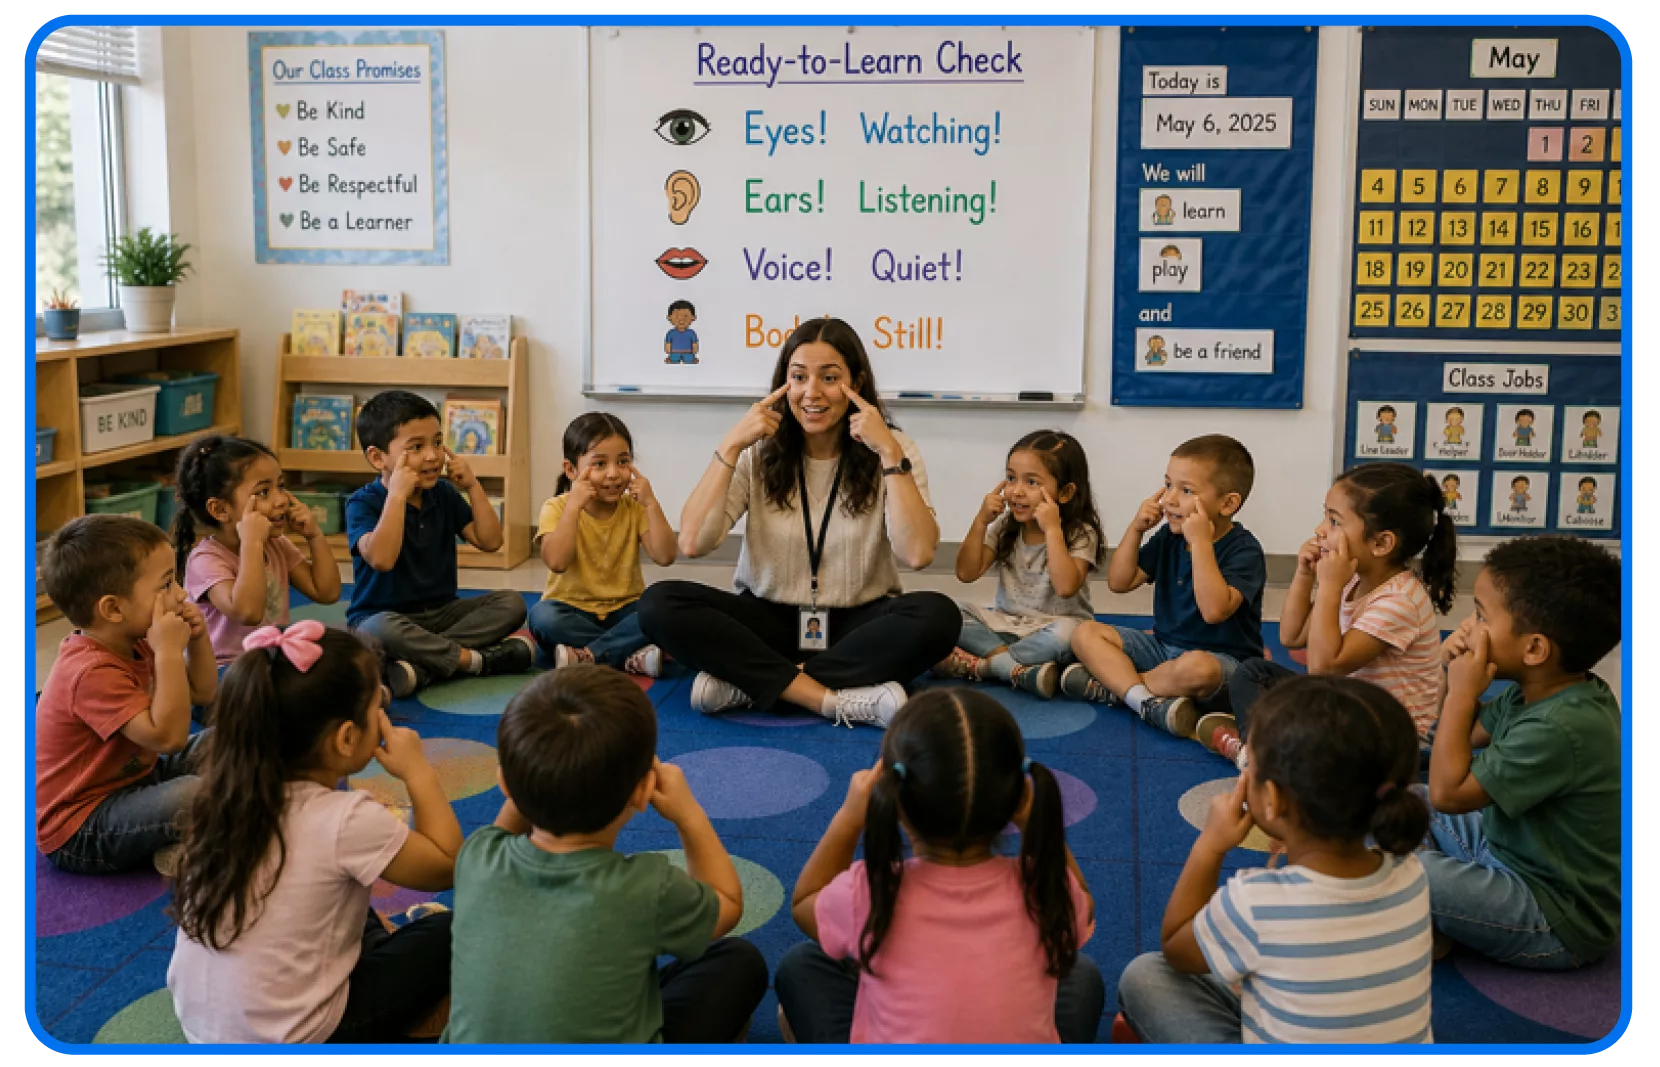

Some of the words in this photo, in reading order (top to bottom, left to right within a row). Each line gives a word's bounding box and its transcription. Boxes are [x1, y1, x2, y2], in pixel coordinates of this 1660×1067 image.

[273, 59, 303, 80] Our
[310, 59, 349, 80] Class
[357, 59, 421, 78] Promises
[697, 42, 923, 88] Ready-to-Learn
[938, 41, 1022, 73] Check
[1490, 47, 1540, 74] May
[1149, 72, 1198, 94] Today
[1207, 73, 1219, 88] is
[298, 100, 317, 120] Be
[327, 101, 364, 119] Kind
[1369, 98, 1396, 112] SUN
[1408, 98, 1439, 112] MON
[1453, 98, 1477, 112] TUE
[1492, 98, 1521, 112] WED
[1535, 98, 1561, 112] THU
[1580, 98, 1600, 112] FRI
[746, 110, 826, 156] Eyes!
[860, 111, 1000, 156] Watching!
[1156, 114, 1194, 138] May
[1204, 114, 1221, 135] 6,
[1229, 114, 1276, 131] 2025
[298, 137, 318, 156] Be
[328, 137, 365, 156] Safe
[1541, 135, 1549, 154] 1
[1580, 134, 1594, 154] 2
[1143, 164, 1169, 182] We
[1177, 164, 1204, 180] will
[300, 174, 318, 192] Be
[328, 174, 417, 199] Respectful
[1371, 177, 1384, 195] 4
[1413, 177, 1426, 195] 5
[1453, 177, 1467, 195] 6
[1496, 177, 1508, 195] 7
[1536, 177, 1549, 197] 8
[1578, 177, 1592, 197] 9
[746, 180, 823, 213] Ears!
[860, 180, 996, 225] Listening!
[1184, 202, 1225, 219] learn
[300, 211, 320, 229] Be
[328, 218, 339, 229] a
[347, 212, 412, 230] Learner
[1369, 218, 1384, 236] 11
[1408, 218, 1427, 237] 12
[1449, 218, 1468, 238] 13
[1489, 219, 1509, 238] 14
[1531, 219, 1551, 238] 15
[1572, 220, 1592, 239] 16
[744, 247, 832, 280] Voice!
[873, 249, 961, 282] Quiet!
[1152, 260, 1188, 285] play
[1365, 259, 1385, 279] 18
[1406, 260, 1426, 279] 19
[1443, 260, 1469, 279] 20
[1485, 261, 1506, 279] 21
[1525, 261, 1549, 280] 22
[1566, 261, 1592, 281] 23
[1607, 261, 1622, 281] 2
[1139, 303, 1171, 321] and
[1360, 300, 1385, 320] 25
[1400, 301, 1425, 320] 26
[1441, 302, 1465, 320] 27
[1481, 302, 1506, 321] 28
[1522, 302, 1547, 322] 29
[1563, 303, 1590, 322] 30
[874, 316, 942, 349] Still!
[1174, 344, 1192, 358] be
[1198, 348, 1208, 358] a
[1214, 342, 1261, 360] friend
[1449, 368, 1495, 387] Class
[1503, 370, 1542, 388] Jobs
[97, 415, 113, 433] BE
[117, 408, 147, 430] KIND
